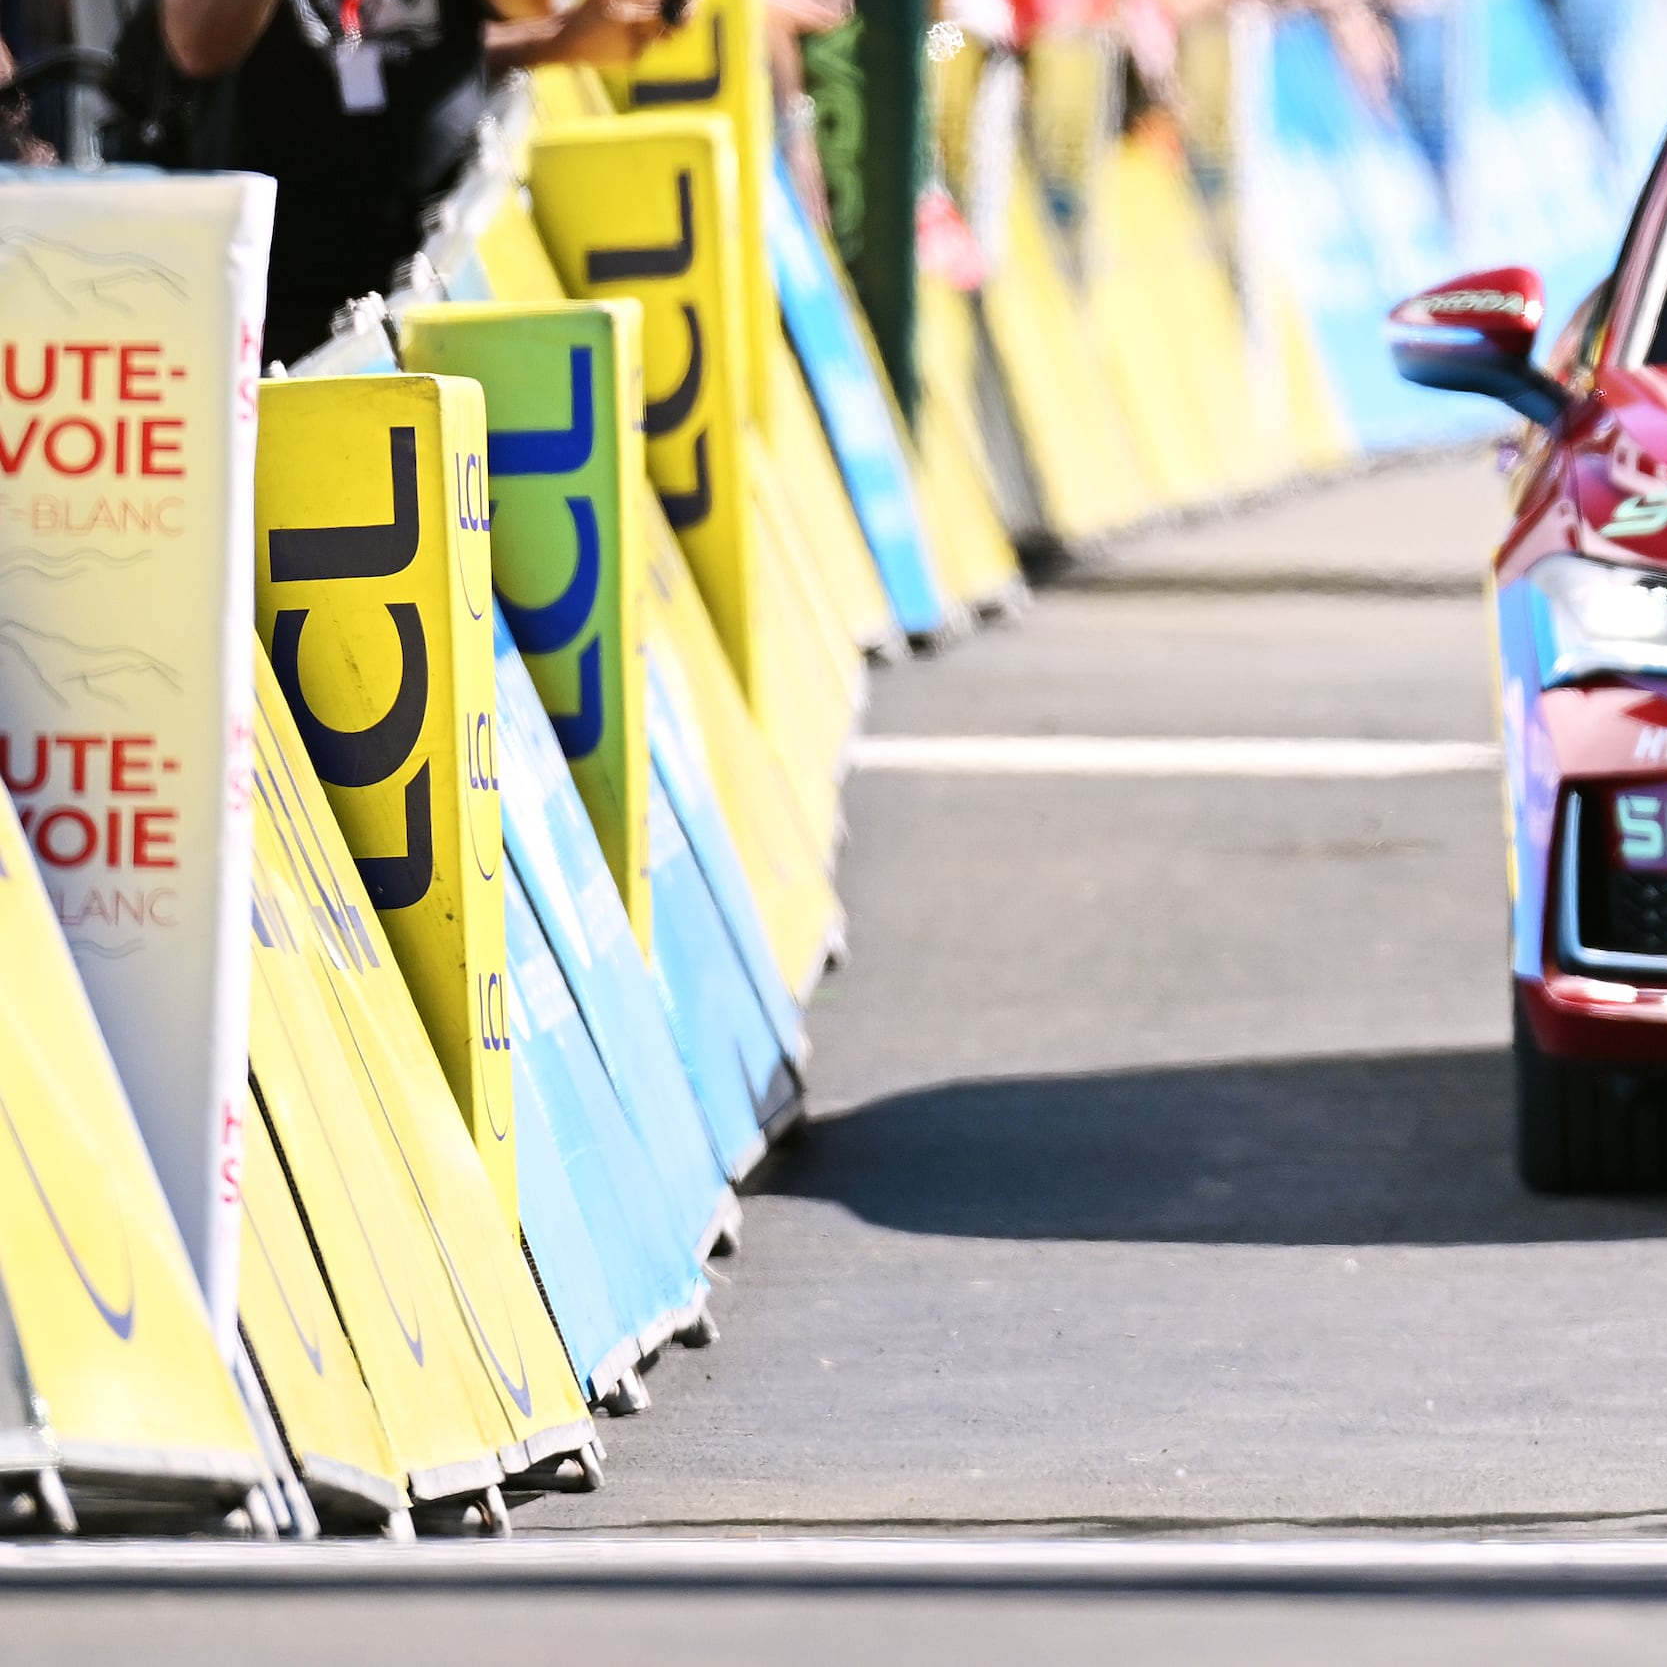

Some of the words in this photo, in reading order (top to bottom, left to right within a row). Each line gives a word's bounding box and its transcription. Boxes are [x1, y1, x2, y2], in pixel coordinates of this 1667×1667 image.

[0, 416, 187, 478] VOIE
[0, 493, 185, 537] -BLANC
[455, 451, 490, 533] LCL
[487, 345, 604, 760] LCL
[270, 426, 434, 910] LCL
[466, 711, 499, 791] LCL
[20, 805, 181, 871] OIE
[477, 972, 511, 1052] LCL
